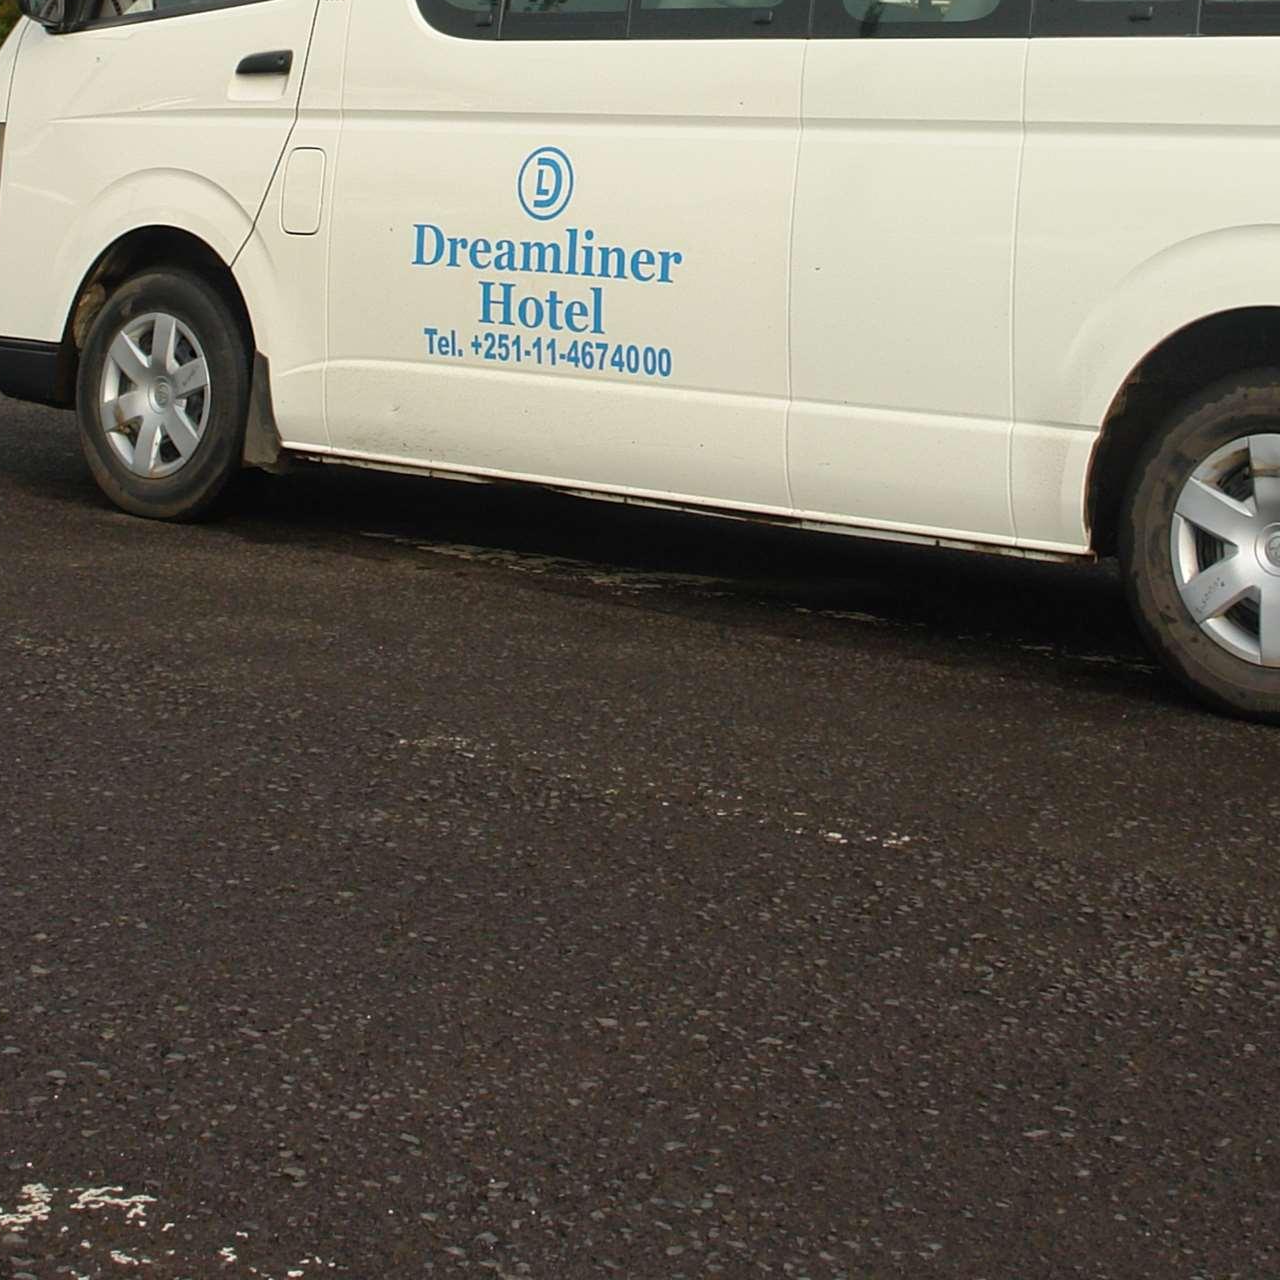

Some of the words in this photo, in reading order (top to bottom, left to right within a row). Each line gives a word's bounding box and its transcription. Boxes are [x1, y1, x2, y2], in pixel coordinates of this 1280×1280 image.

[411, 223, 683, 284] Dreamliner
[478, 280, 605, 335] Hotel
[424, 328, 464, 358] Tel.
[470, 332, 673, 378] +251-11-4674000
